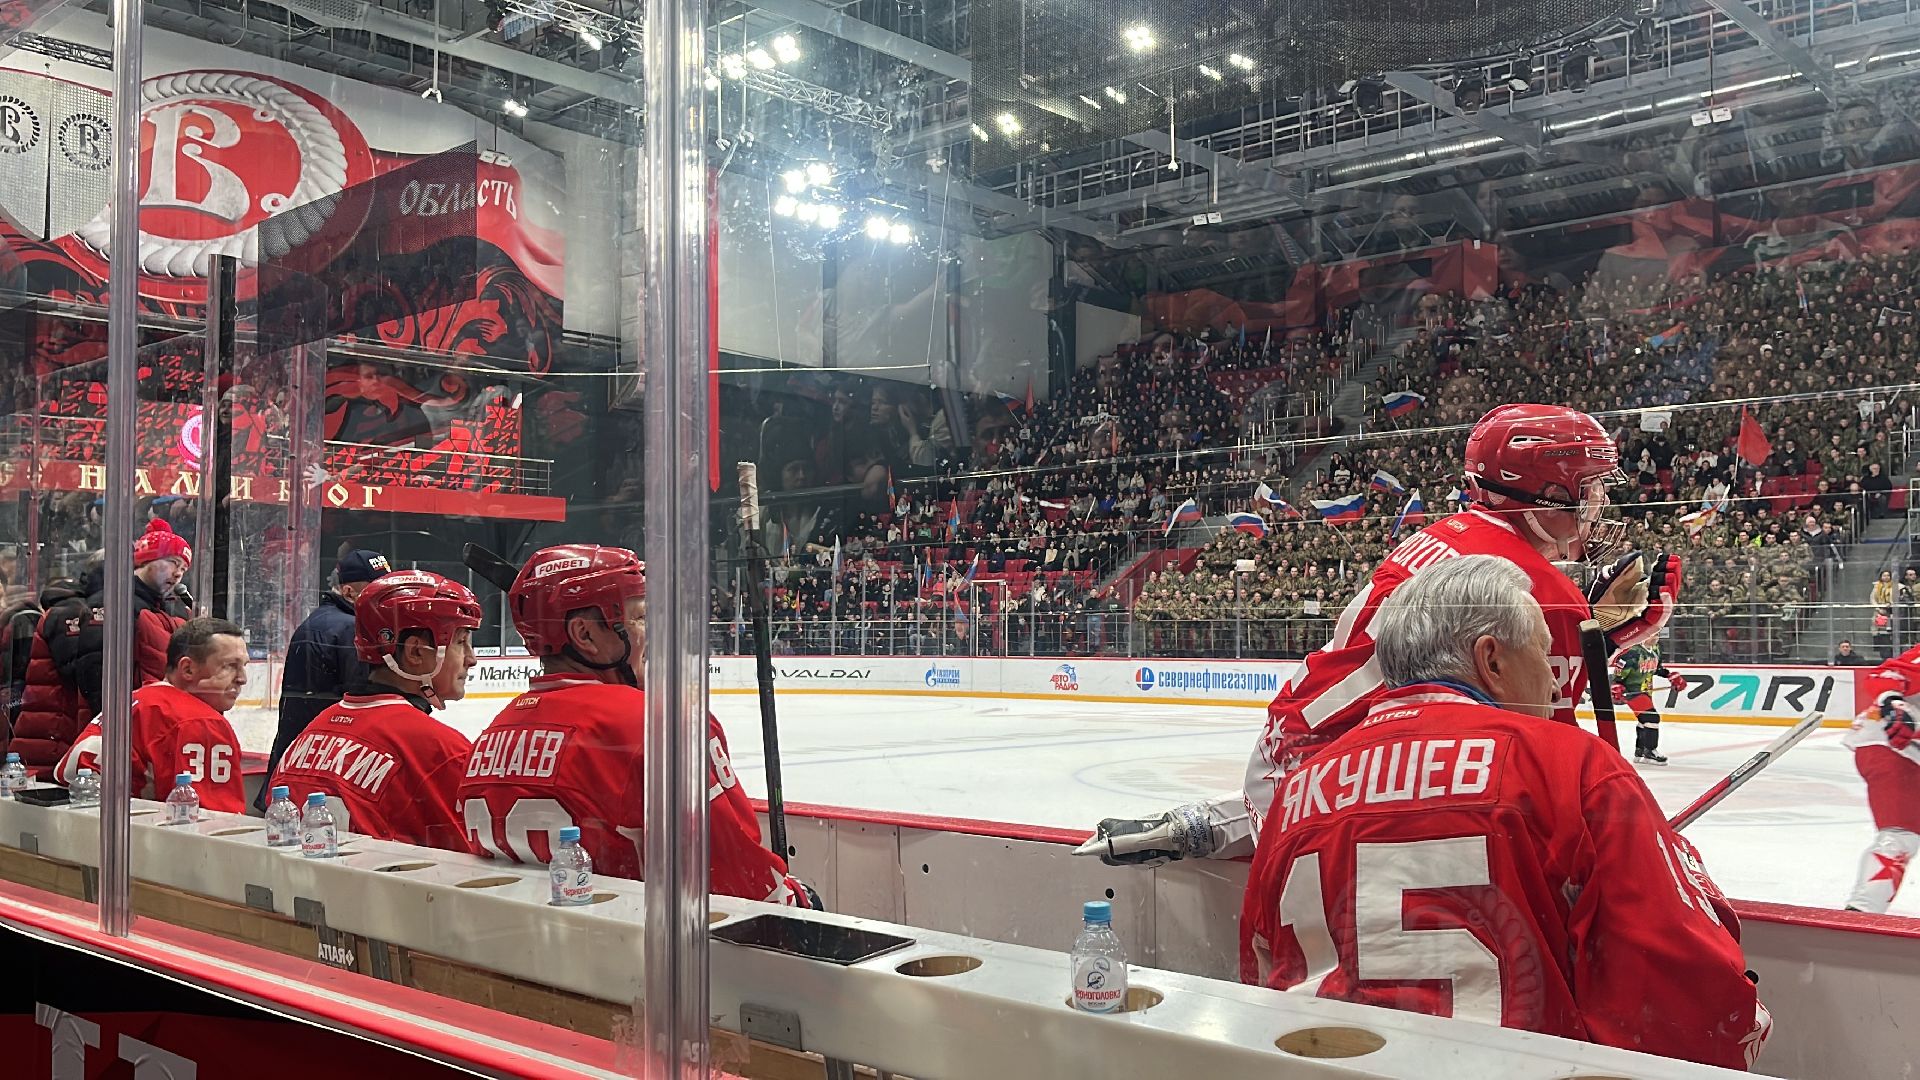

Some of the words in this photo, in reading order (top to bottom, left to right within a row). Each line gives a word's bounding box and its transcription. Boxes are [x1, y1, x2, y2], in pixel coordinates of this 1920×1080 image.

[400, 180, 517, 220] ОБЛАСТЬ
[539, 559, 585, 574] FONBET
[781, 669, 871, 679] VALDAI
[1050, 674, 1069, 683] АВТО
[1665, 674, 1835, 712] PARI
[515, 697, 541, 707] LUTCH
[1362, 708, 1420, 728] LUTCH
[182, 743, 233, 784] 36
[466, 730, 565, 778] БУЦАЕВ
[709, 736, 736, 801] 8
[1281, 738, 1496, 833] ЯКУШЕВ
[1280, 835, 1502, 1027] 15
